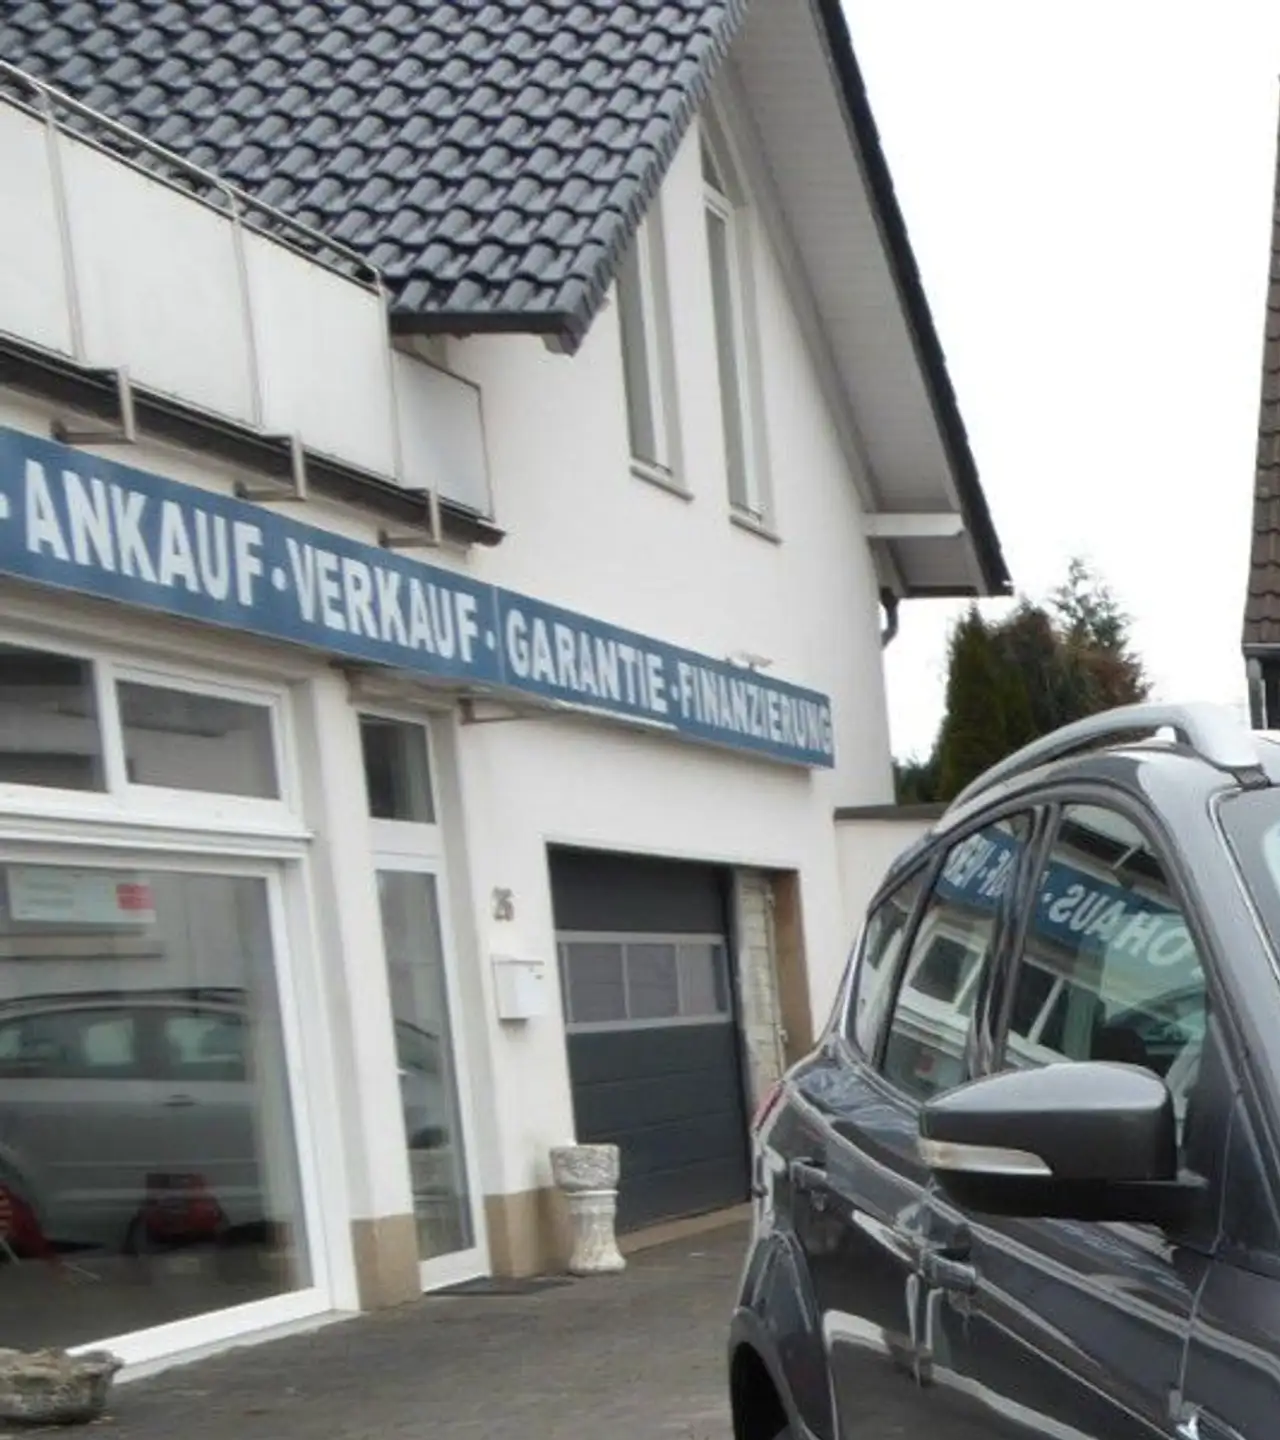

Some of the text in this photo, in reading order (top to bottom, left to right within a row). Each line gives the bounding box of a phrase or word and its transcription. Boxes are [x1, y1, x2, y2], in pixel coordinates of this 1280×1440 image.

[25, 458, 835, 755] ANKAUF VERKAUF GARANTIE FINANZIERUNG
